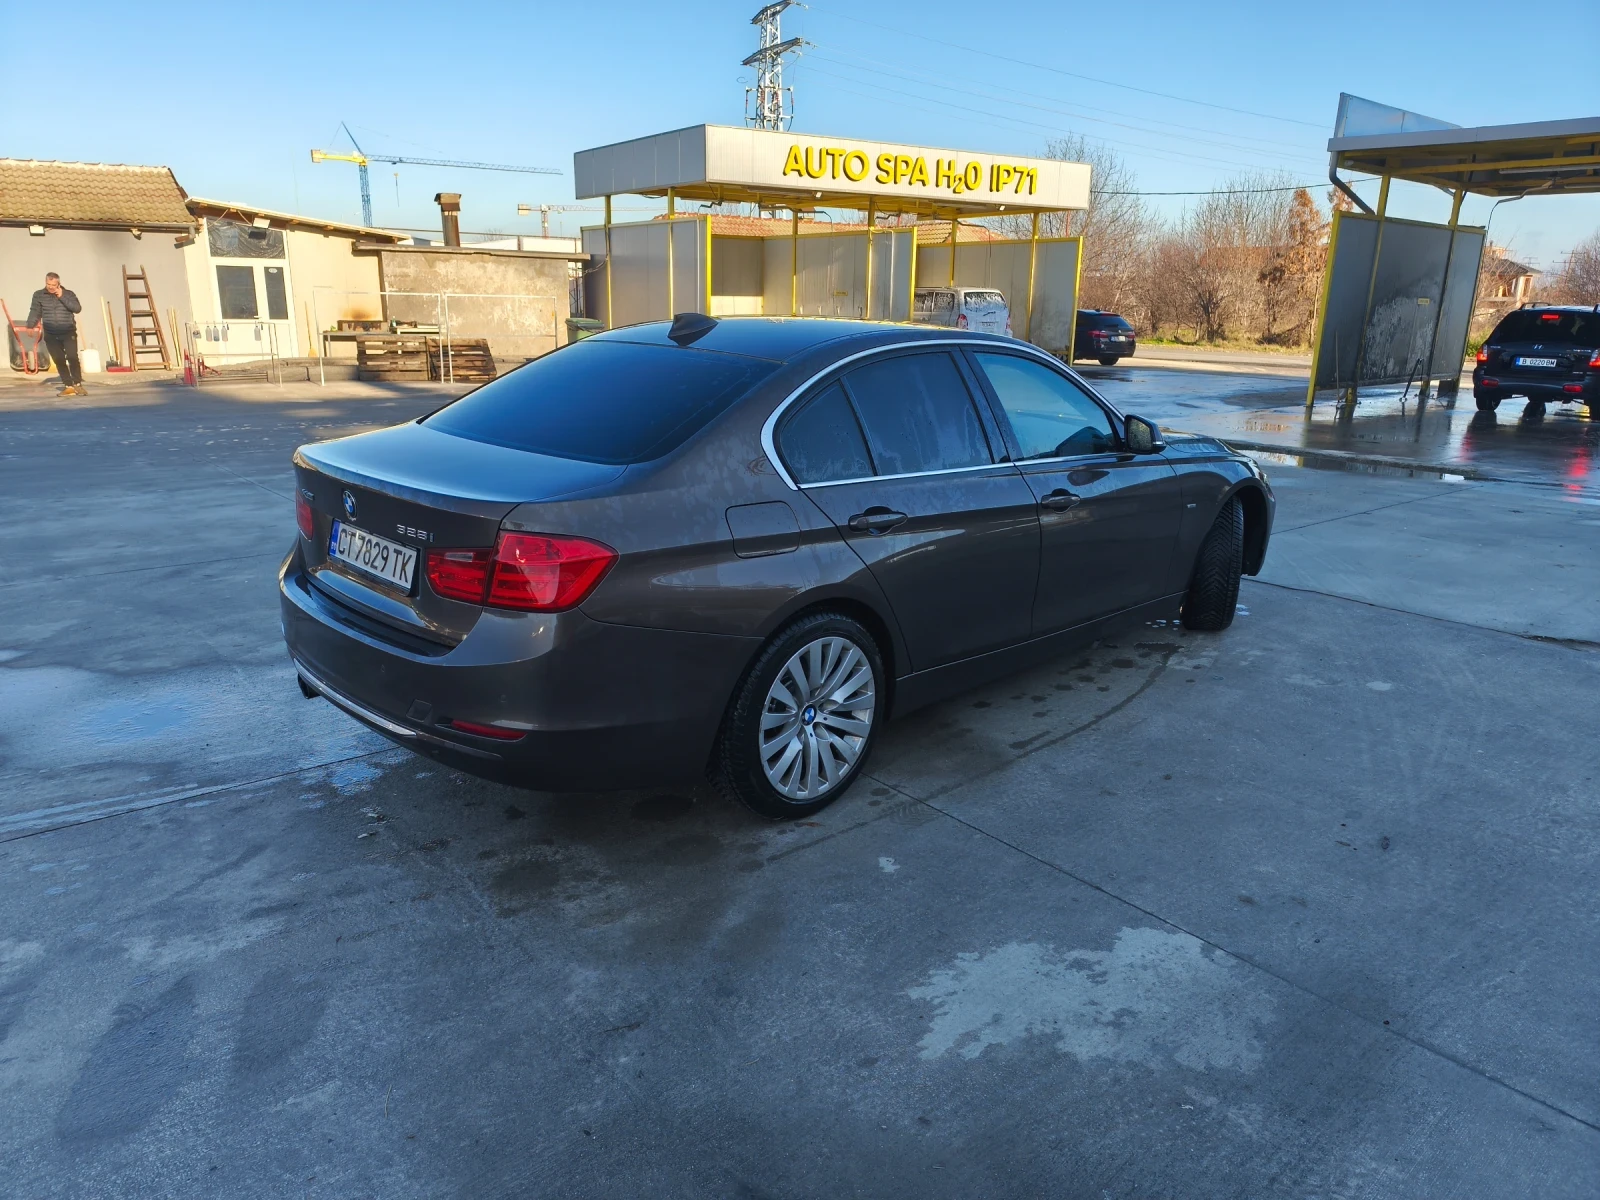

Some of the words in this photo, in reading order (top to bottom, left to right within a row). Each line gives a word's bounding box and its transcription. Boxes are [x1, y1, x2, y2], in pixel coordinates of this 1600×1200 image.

[783, 145, 870, 181] AUTO
[875, 153, 929, 187] SPA
[989, 164, 1038, 195] IP71
[396, 524, 434, 542] 328i
[392, 547, 412, 584] TK
